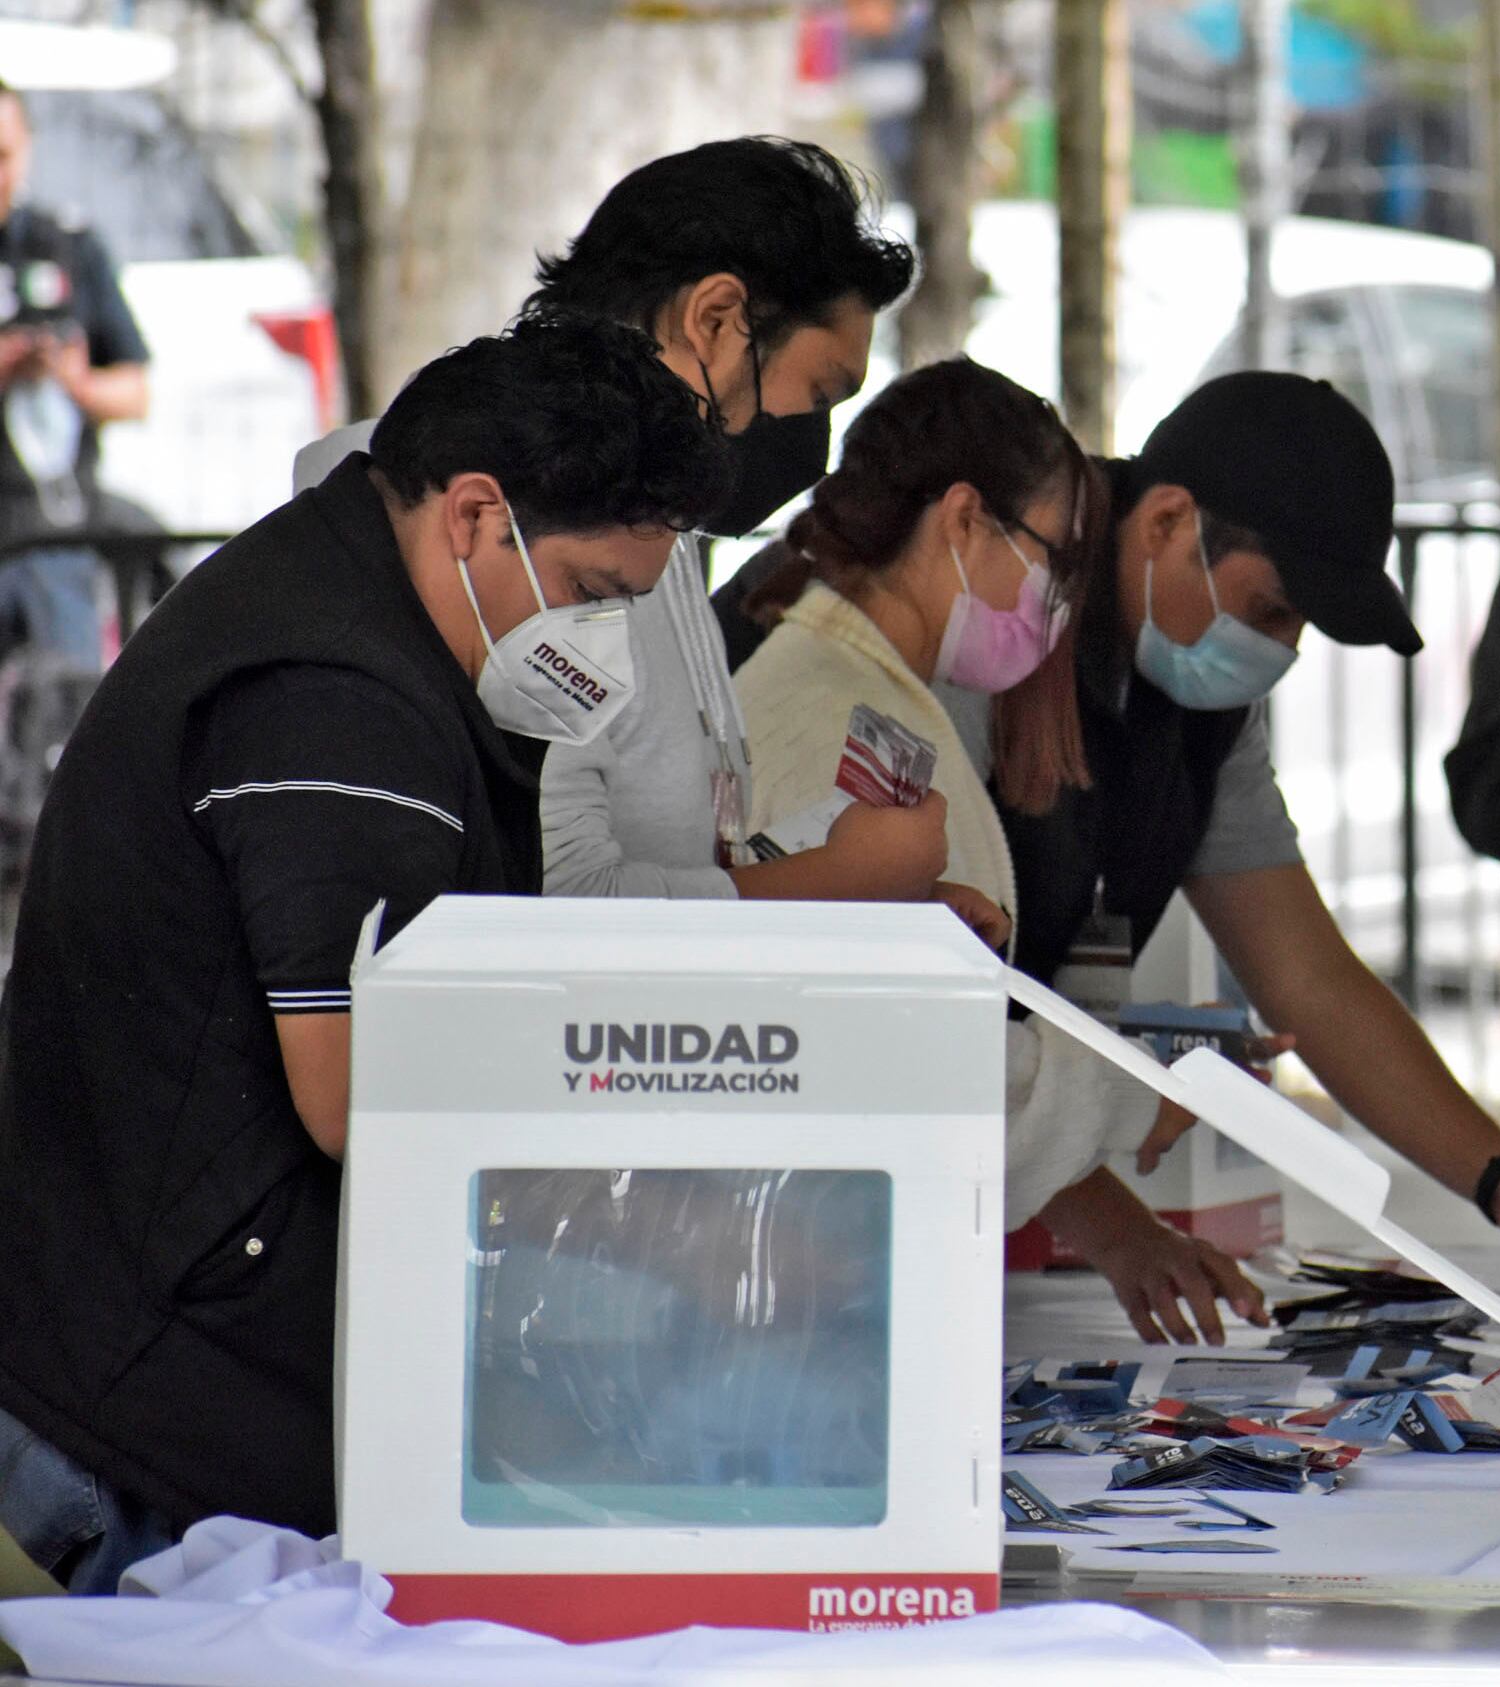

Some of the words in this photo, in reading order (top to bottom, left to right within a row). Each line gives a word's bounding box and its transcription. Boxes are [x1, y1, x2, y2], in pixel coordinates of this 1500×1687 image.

[533, 642, 608, 704] morena
[564, 1023, 800, 1065] UNIDAD
[563, 1072, 582, 1093] Y
[590, 1067, 800, 1094] MOVILIZACIÓN
[808, 1587, 977, 1617] morena
[809, 1618, 826, 1633] La
